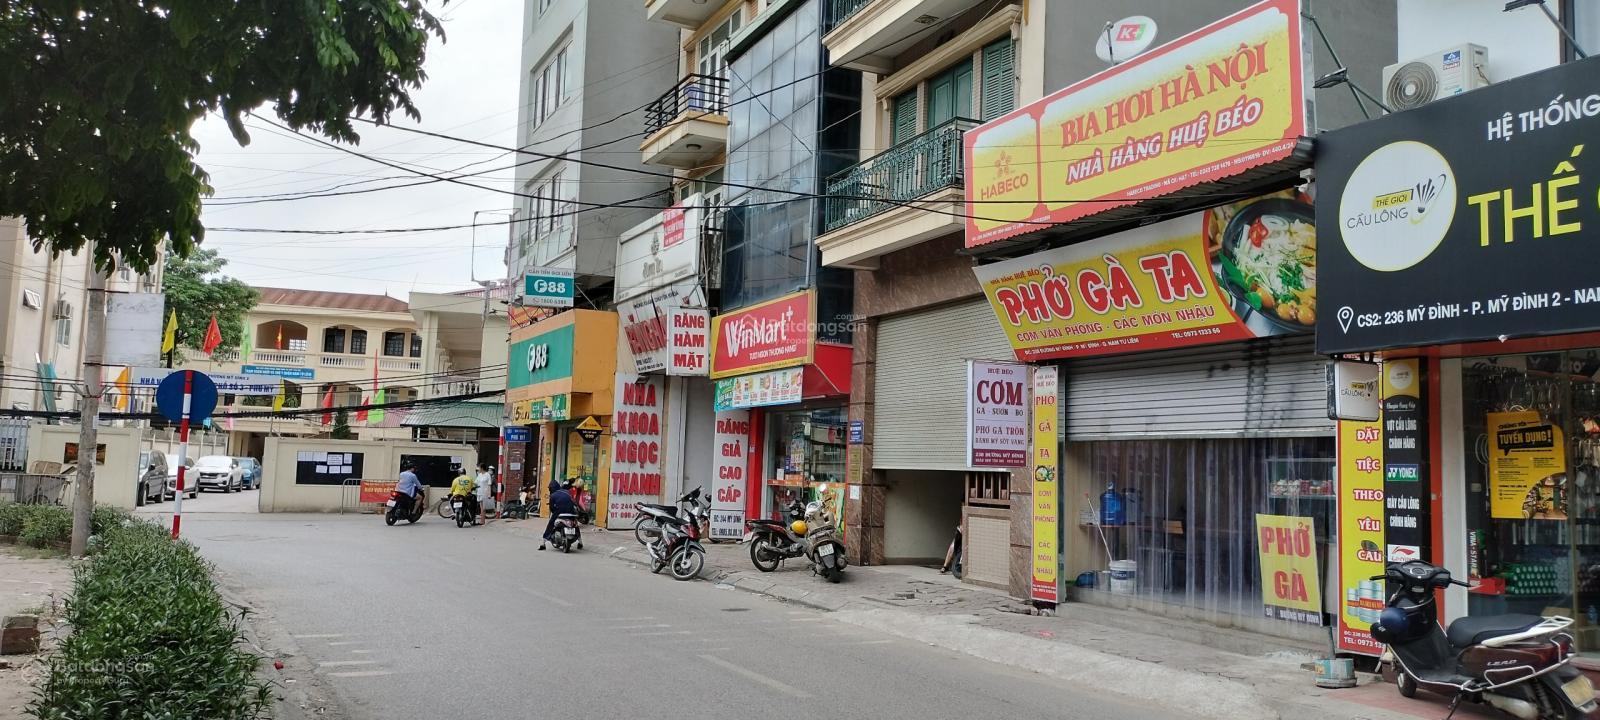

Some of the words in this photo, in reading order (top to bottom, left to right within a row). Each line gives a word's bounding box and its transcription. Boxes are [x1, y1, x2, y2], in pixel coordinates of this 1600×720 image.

[1061, 111, 1098, 149] BIA
[1104, 87, 1155, 135] HƠI
[1158, 64, 1204, 113] HÀ
[1206, 42, 1269, 97] NỘI
[1488, 111, 1513, 142] HỆ
[1519, 94, 1600, 133] THỐNG
[1067, 149, 1102, 184] NHÀ
[1110, 131, 1161, 170] HÀNG
[1168, 111, 1208, 152] HUỆ
[1215, 94, 1262, 134] BÉO
[981, 172, 1029, 200] HABECO
[1467, 144, 1584, 247] THẾ
[1374, 206, 1409, 224] LÔNG
[534, 279, 566, 293] F88
[997, 265, 1073, 325] PHỞ
[1078, 255, 1141, 313] GÀ
[1141, 251, 1206, 301] TA
[1357, 313, 1382, 328] CS2:
[1384, 310, 1404, 324] 236
[1406, 303, 1426, 322] MỸ
[1428, 301, 1460, 320] ĐÌNH
[1472, 301, 1485, 315] P.
[1488, 294, 1509, 314] MỸ
[1512, 291, 1548, 312] ĐÌNH
[1552, 293, 1561, 307] 2
[674, 313, 705, 329] RĂNG
[674, 332, 705, 348] HÀM
[527, 344, 548, 372] F88
[674, 352, 705, 371] MẶT
[976, 380, 1023, 406] CƠM
[617, 411, 659, 436] KHOA
[717, 417, 749, 435] RĂNG
[1357, 427, 1379, 444] ĐẶT
[615, 439, 659, 469] NGỌC
[1356, 456, 1380, 473] TIỆC
[719, 465, 742, 481] CAO
[1399, 467, 1417, 478] YONEX
[611, 472, 661, 497] THANH
[717, 484, 742, 503] CẤP
[1353, 489, 1384, 501] THEO
[1358, 516, 1381, 532] YÊU
[1260, 521, 1312, 558] PHỞ
[1274, 568, 1309, 602] GÀ
[1357, 638, 1374, 647] 0973
